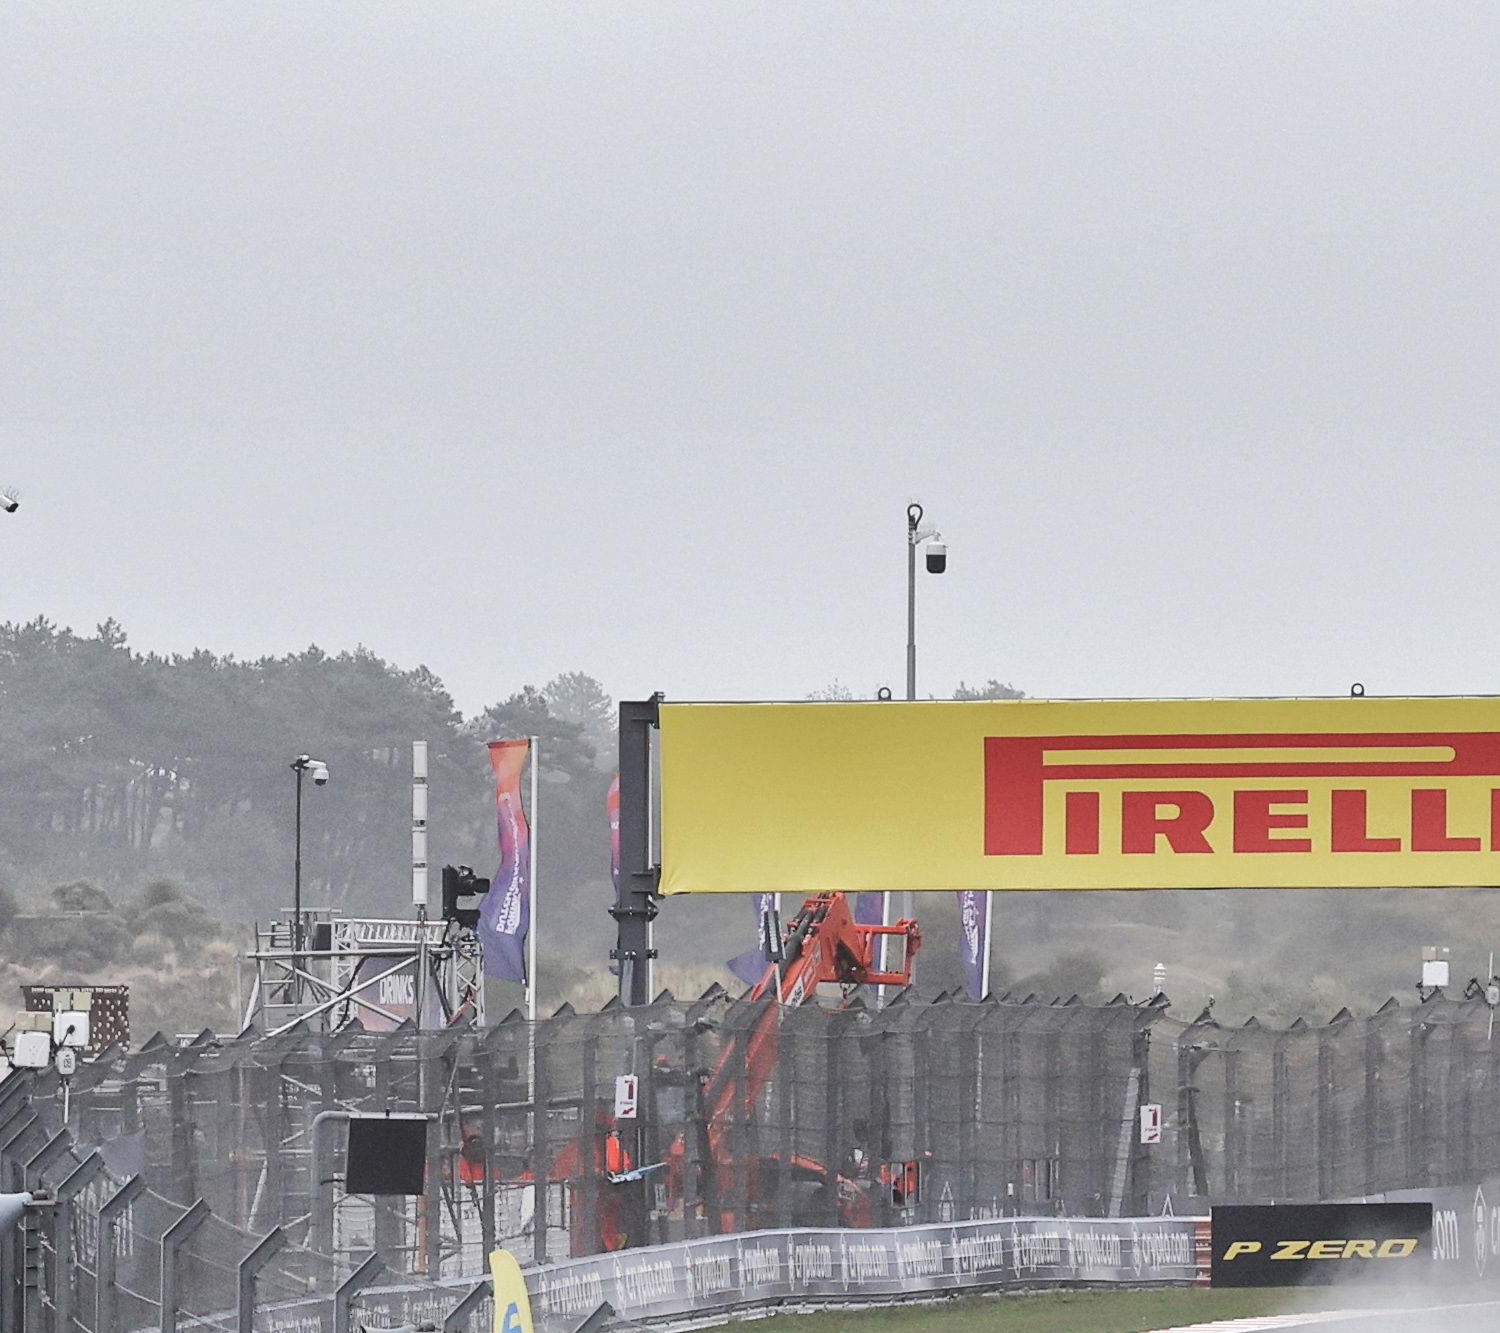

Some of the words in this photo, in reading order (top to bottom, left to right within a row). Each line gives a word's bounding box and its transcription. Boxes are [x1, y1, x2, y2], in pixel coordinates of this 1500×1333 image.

[380, 974, 414, 1005] DRINKS
[1141, 1224, 1191, 1272] crypto.com
[1223, 1241, 1262, 1261] P
[1270, 1238, 1419, 1260] ZERO
[626, 1257, 676, 1309] crypto.com
